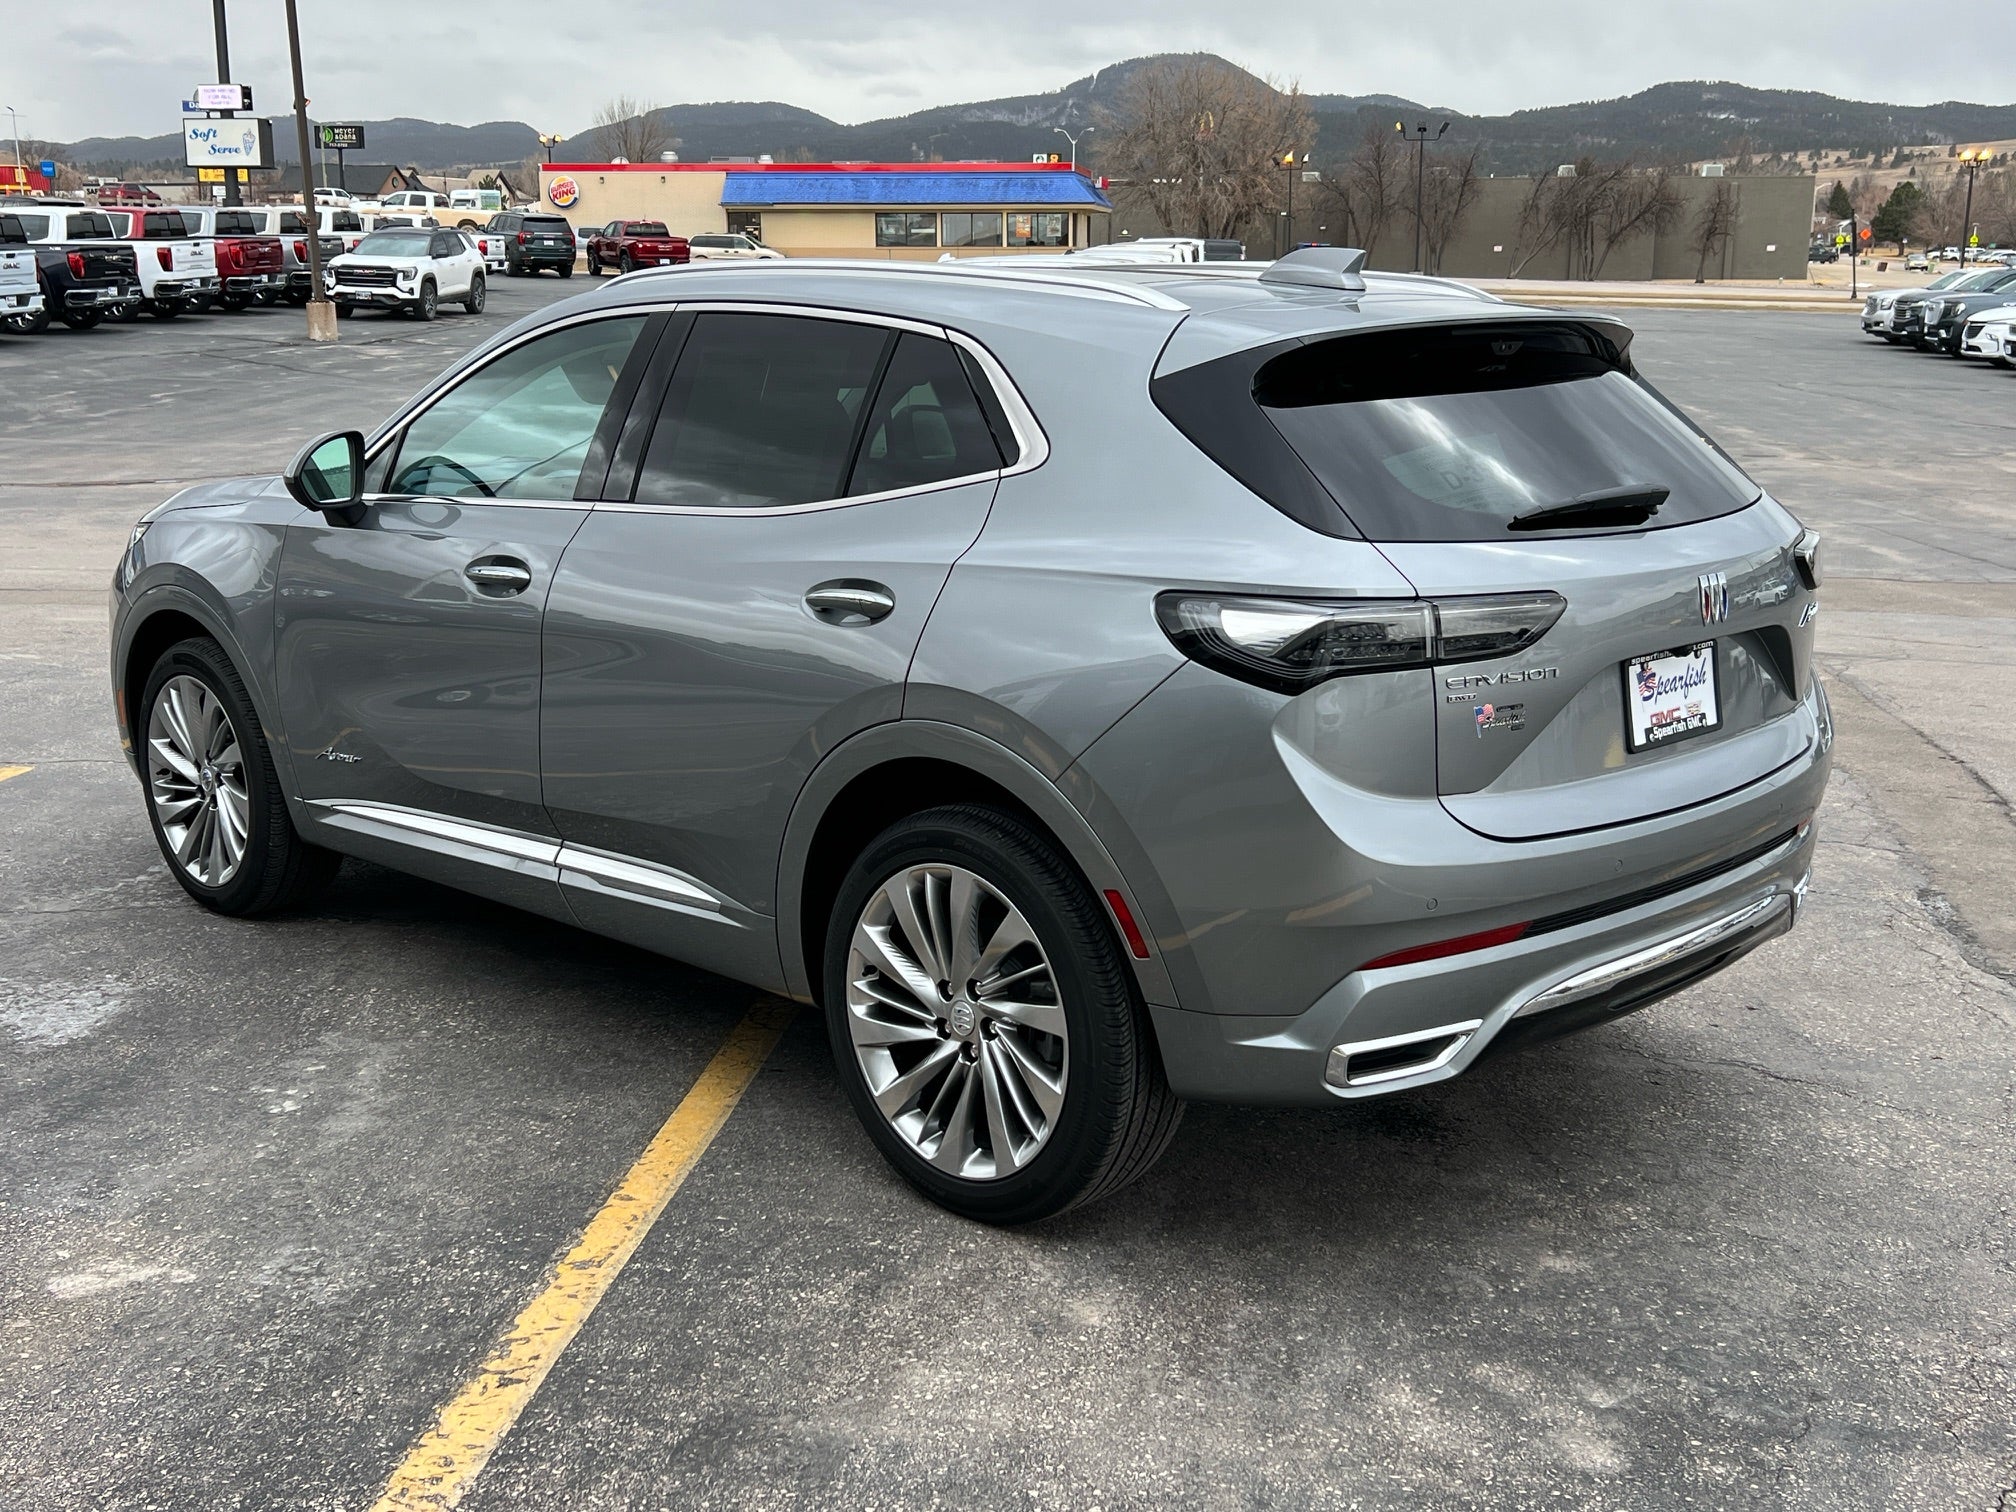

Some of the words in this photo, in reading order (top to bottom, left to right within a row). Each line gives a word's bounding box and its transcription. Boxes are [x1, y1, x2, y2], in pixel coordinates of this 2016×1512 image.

[189, 128, 218, 142] Soft
[208, 144, 242, 155] Serve
[551, 180, 575, 193] BURGER
[552, 186, 576, 201] KING
[2, 262, 20, 270] GMC
[1446, 667, 1559, 689] ENVISION
[1642, 657, 1707, 705] Spearfish
[1650, 706, 1681, 726] GMC
[1653, 718, 1687, 740] Spearfish
[1687, 714, 1703, 730] GMC
